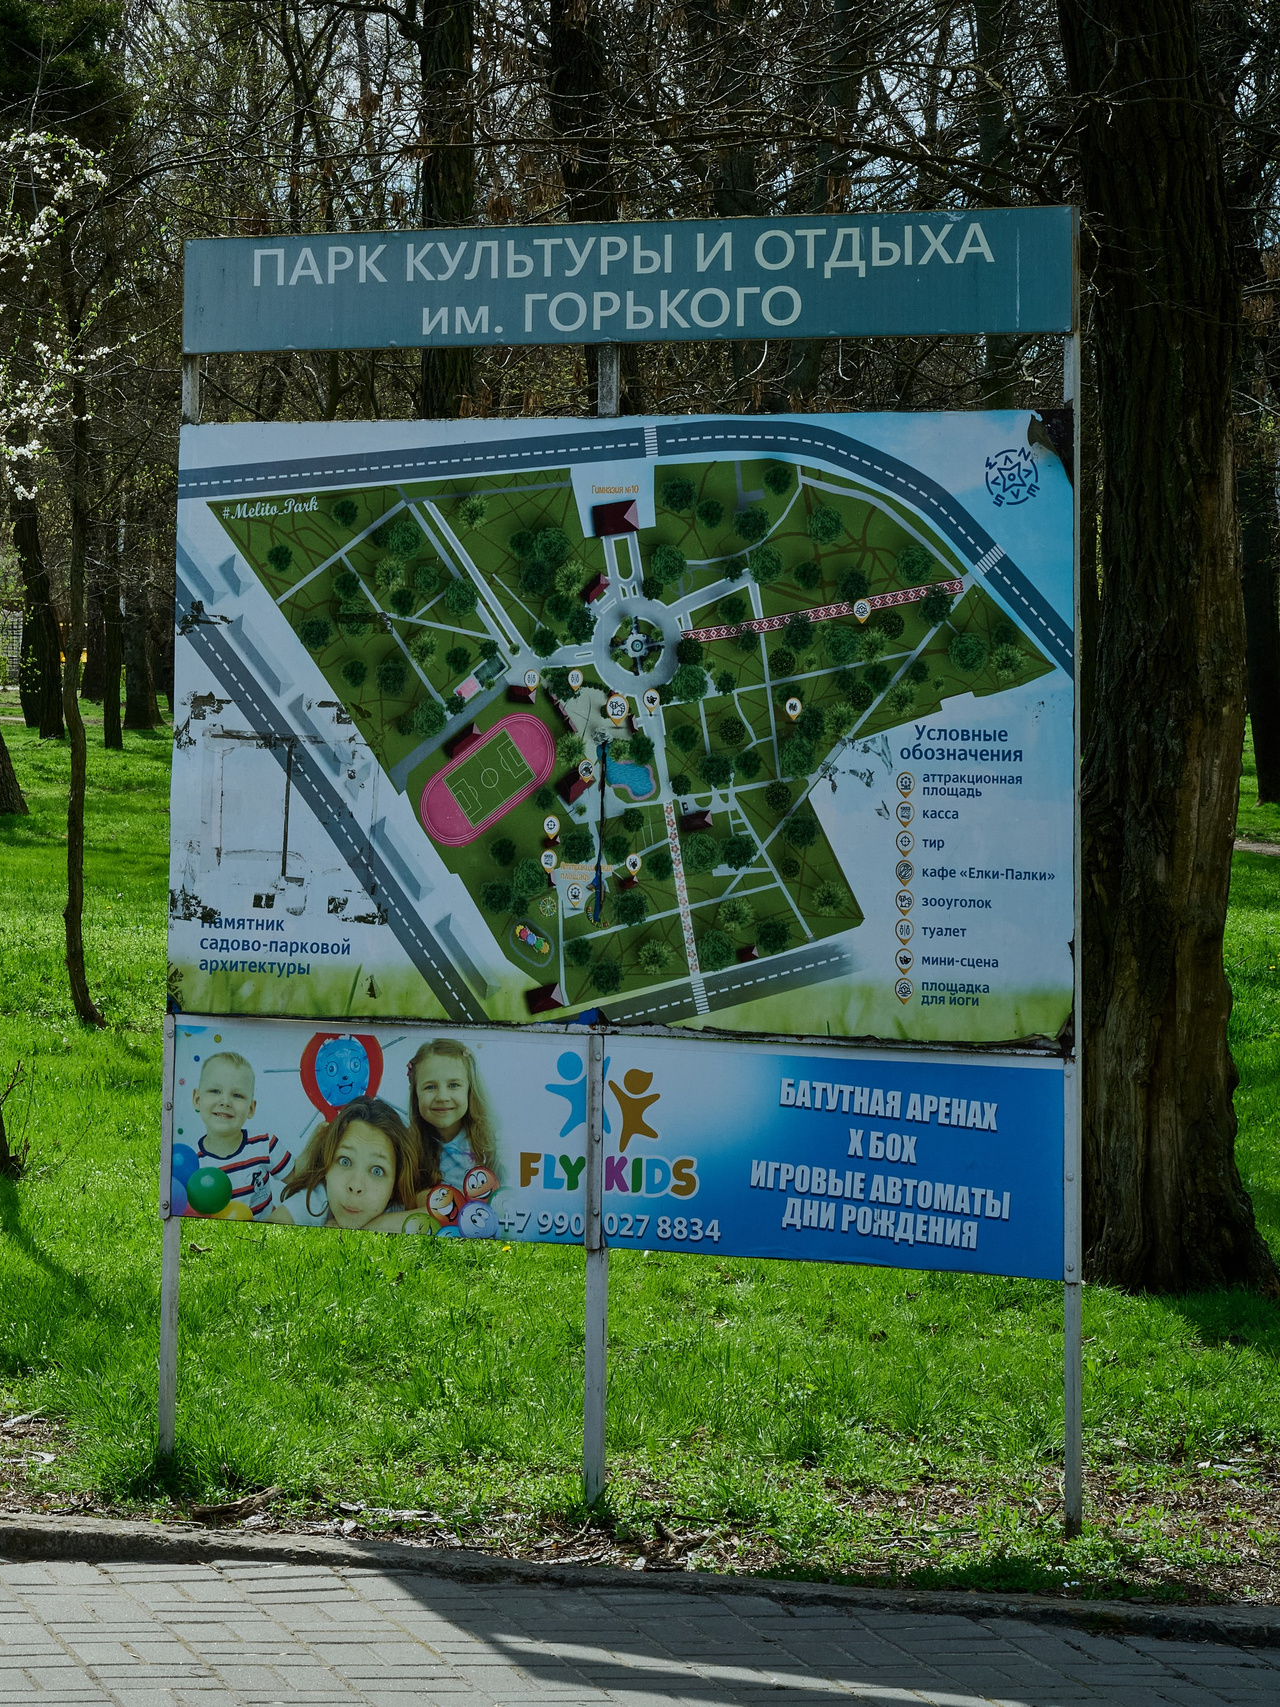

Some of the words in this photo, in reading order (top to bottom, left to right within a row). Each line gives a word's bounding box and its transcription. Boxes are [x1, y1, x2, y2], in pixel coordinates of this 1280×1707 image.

[252, 243, 387, 287] ПАРК
[404, 233, 673, 282] КУЛЬТУРЫ
[696, 231, 733, 272] И
[753, 222, 996, 280] ОТДЫХА
[422, 303, 504, 336] им.
[524, 285, 803, 333] ГОРЬКОГО
[591, 485, 623, 494] Гимназия
[222, 495, 320, 519] #Melito_Park
[914, 724, 1009, 743] Условные
[899, 744, 1024, 762] обозначения
[922, 772, 1023, 786] аттракционная
[922, 786, 983, 799] площадь
[922, 808, 959, 820] касса
[922, 837, 945, 851] тир
[922, 865, 957, 882] кафе
[959, 866, 1056, 882] «Елки-Палки»
[921, 896, 992, 910] зооуголок
[921, 925, 967, 939] туалет
[200, 937, 351, 957] садово-парковой
[199, 959, 311, 978] архитектуры
[921, 955, 999, 969] мини-сцена
[921, 980, 990, 994] площадка
[921, 994, 946, 1006] для
[949, 991, 980, 1008] йоги
[779, 1078, 902, 1119] БАТУТНАЯ
[905, 1092, 998, 1131] АРЕНАХ
[868, 1131, 918, 1164] БОХ
[520, 1152, 586, 1191] FLY
[605, 1155, 697, 1197] KIDS
[750, 1159, 866, 1202] ИГРОВЫЕ
[870, 1174, 1011, 1220] АВТОМАТЫ
[498, 1211, 531, 1233] +7
[537, 1212, 585, 1235] 990
[603, 1213, 650, 1238] 027
[656, 1216, 721, 1242] 8834
[781, 1197, 836, 1232] ДНИ
[841, 1204, 979, 1250] РОЖДЕНИЯ
